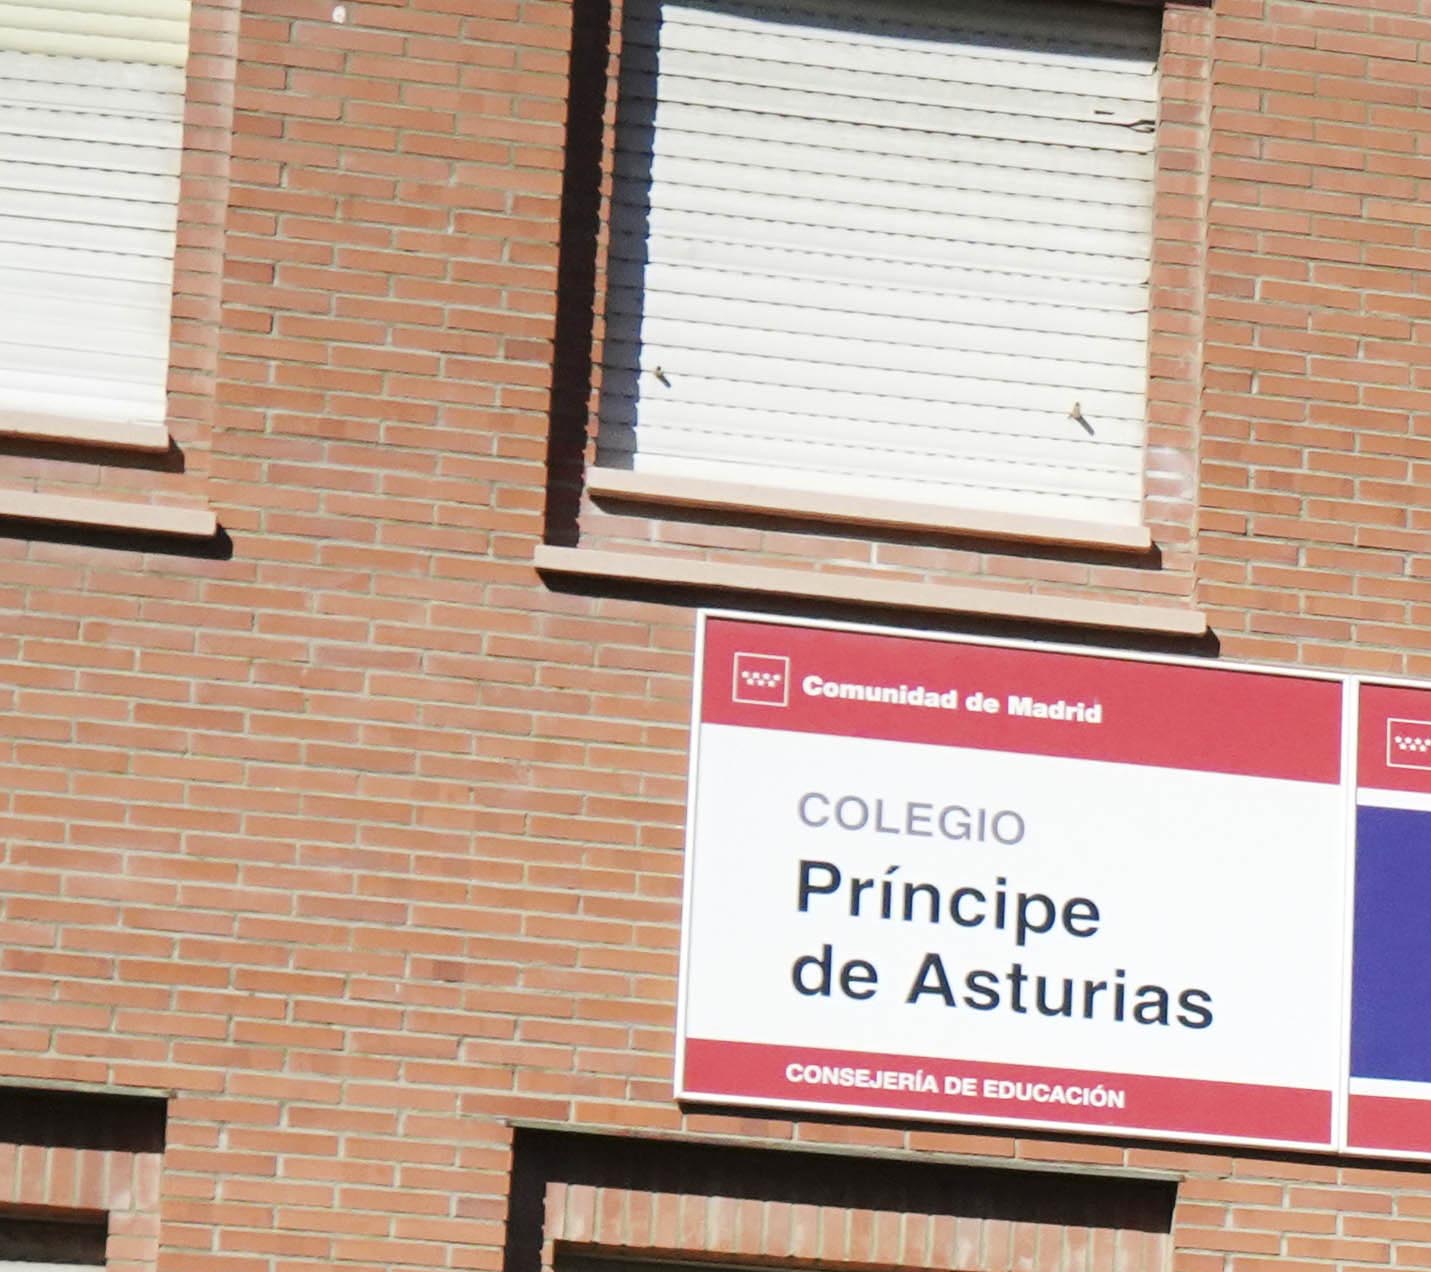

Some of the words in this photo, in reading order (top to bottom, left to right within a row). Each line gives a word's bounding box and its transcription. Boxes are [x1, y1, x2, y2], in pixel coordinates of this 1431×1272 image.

[802, 675, 957, 710] Comunidad
[965, 692, 1000, 713] de
[1008, 695, 1103, 723] Madrid
[797, 792, 1026, 845] COLEGIO
[796, 859, 1101, 946] Príncipe
[791, 944, 879, 1001] de
[905, 952, 1214, 1030] Asturias
[785, 1063, 939, 1093] CONSEJERÍA
[944, 1076, 977, 1096] DE
[983, 1079, 1126, 1108] EDUCACIÓN
